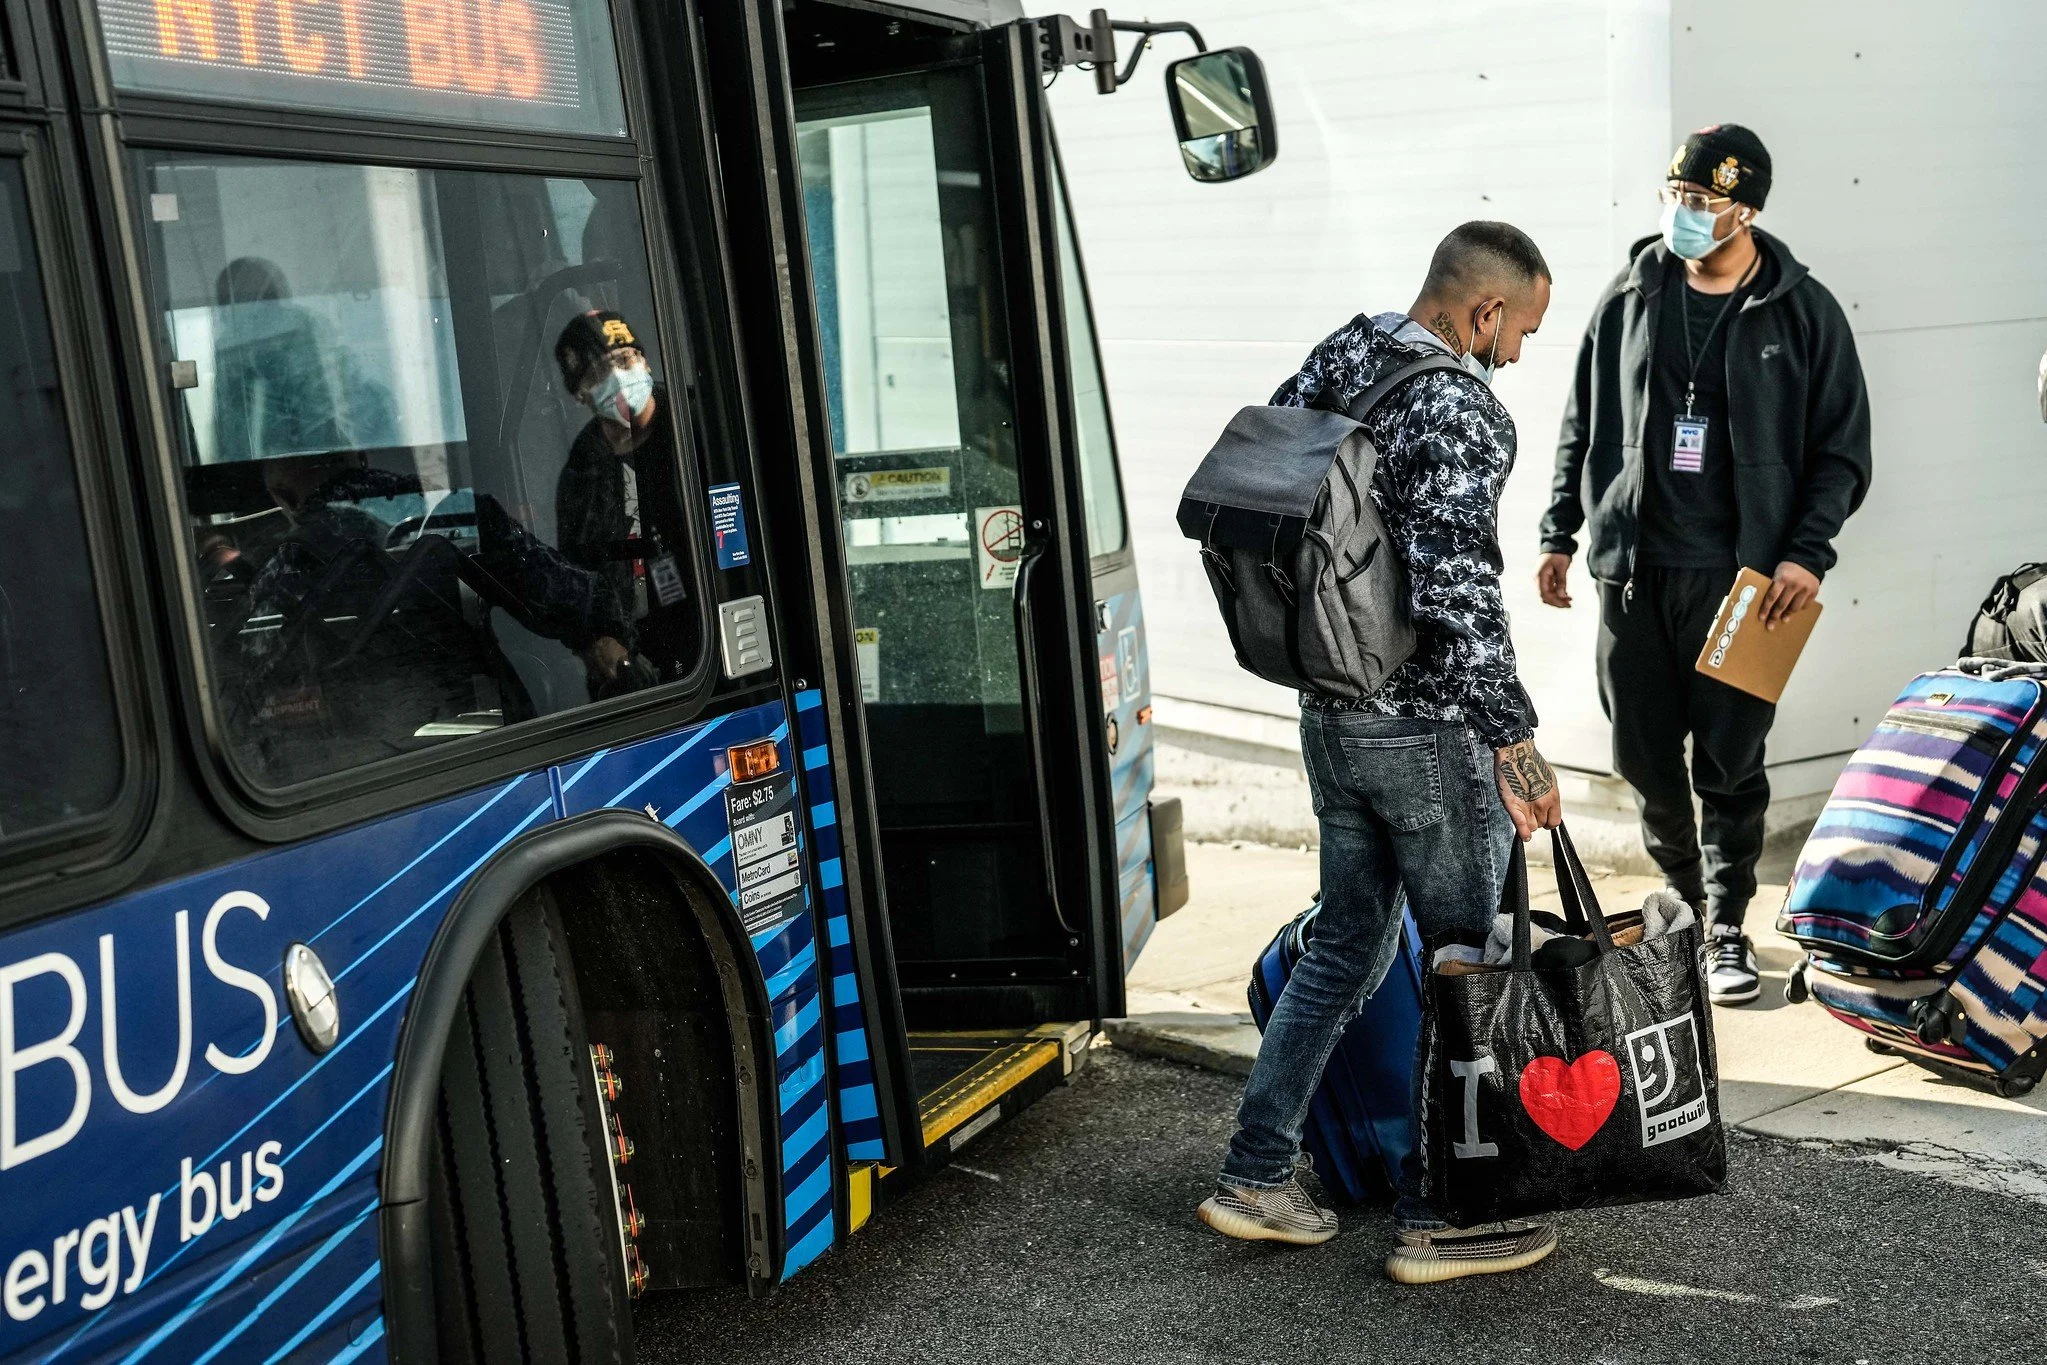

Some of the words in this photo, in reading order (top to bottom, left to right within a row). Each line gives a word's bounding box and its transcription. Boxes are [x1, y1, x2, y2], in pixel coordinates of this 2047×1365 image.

[404, 0, 541, 98] BUS
[887, 471, 942, 484] CAUTION
[712, 494, 739, 506] Assaulting
[717, 530, 724, 549] 7
[730, 797, 752, 813] Fare:
[752, 785, 774, 807] $2.75
[737, 826, 763, 850] OMNY
[741, 863, 771, 884] MetroCard
[744, 891, 760, 905] Coins
[0, 890, 278, 1171] BUS
[1450, 1055, 1499, 1159] I
[1647, 1100, 1706, 1142] goodwill
[0, 1192, 162, 1322] ergy
[180, 1140, 285, 1243] bus
